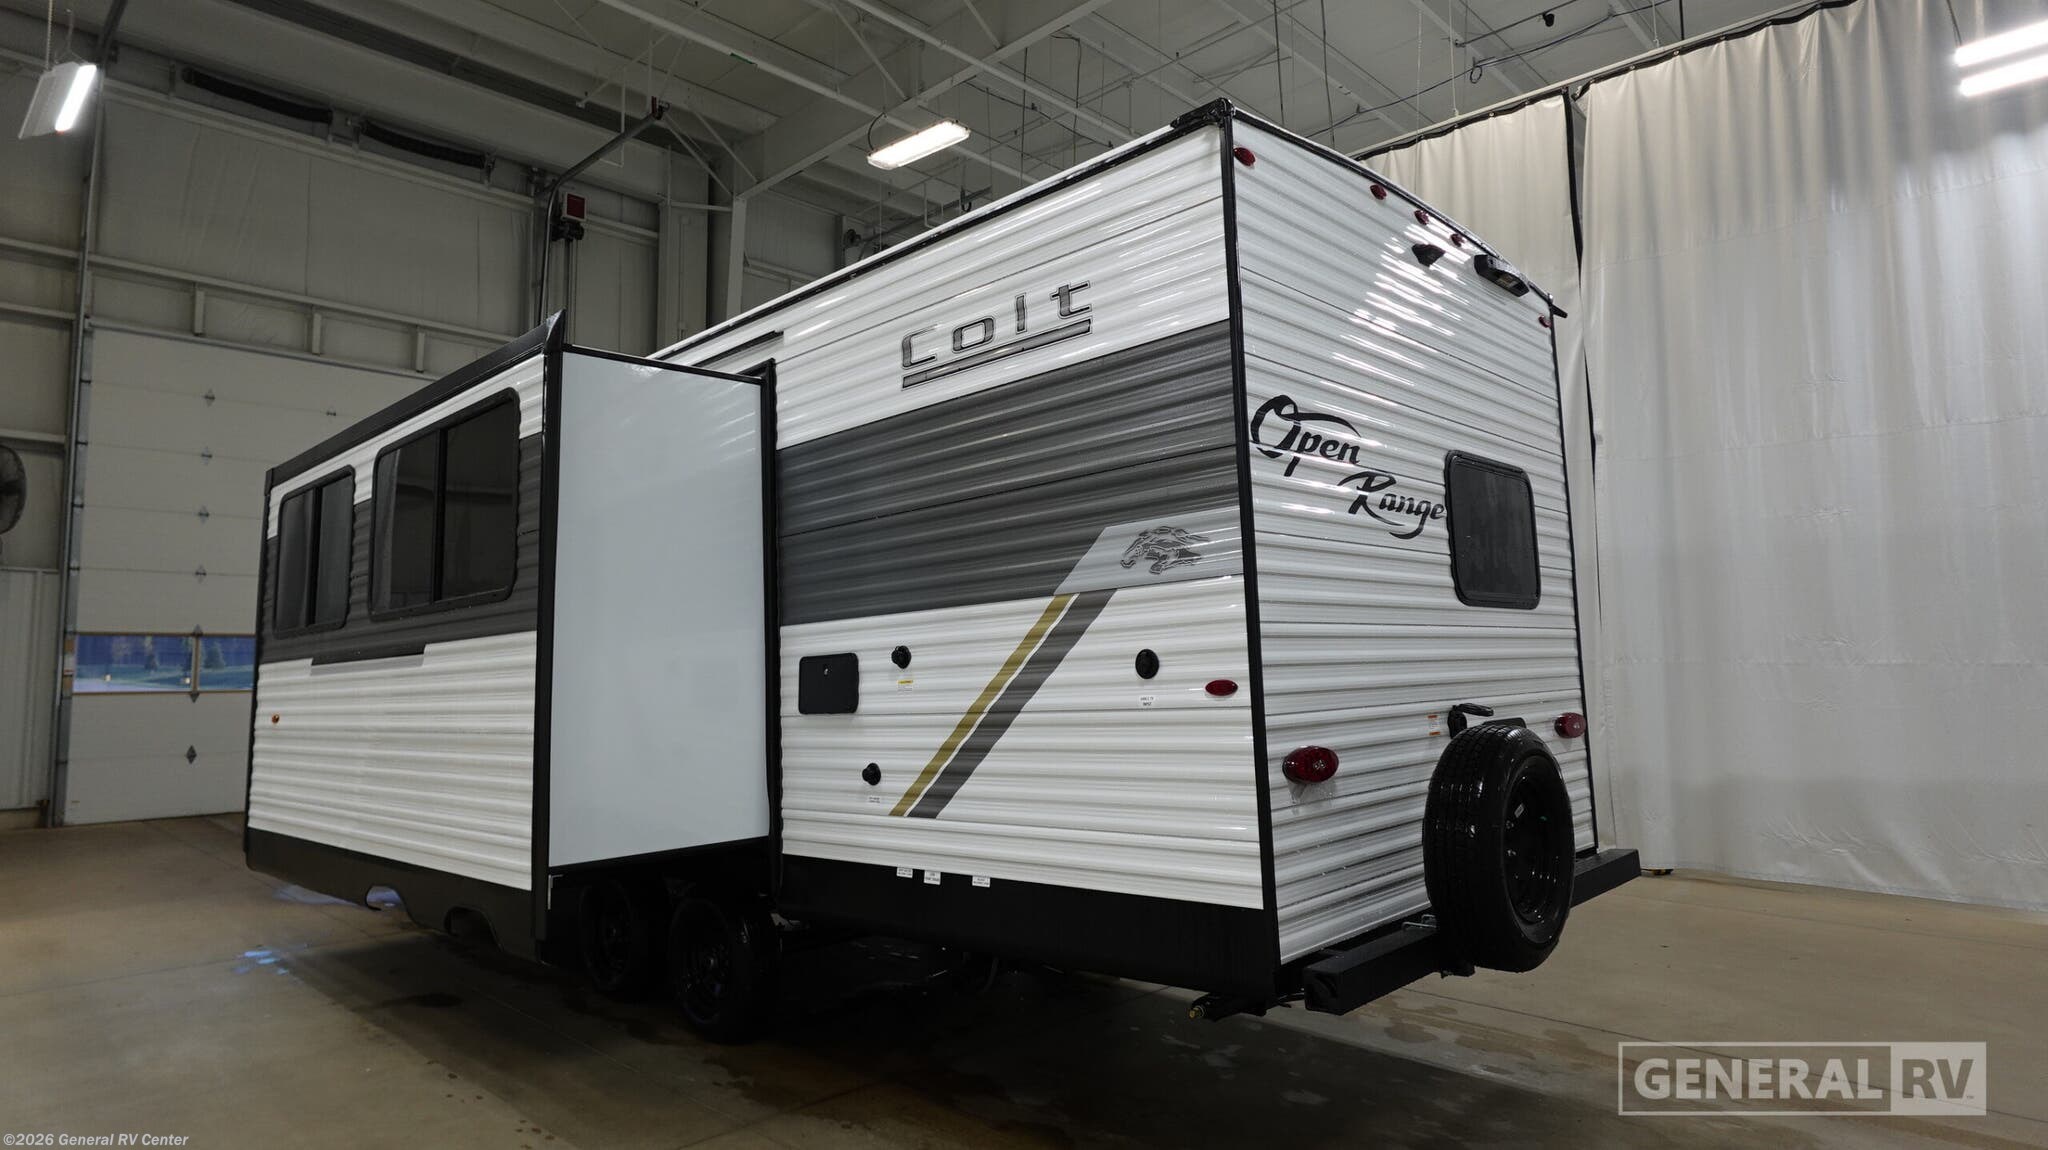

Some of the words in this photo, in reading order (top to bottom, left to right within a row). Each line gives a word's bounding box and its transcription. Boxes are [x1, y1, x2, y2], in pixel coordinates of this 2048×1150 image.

[902, 283, 1091, 368] Colt
[1251, 394, 1362, 477] Open
[1337, 471, 1445, 540] Range
